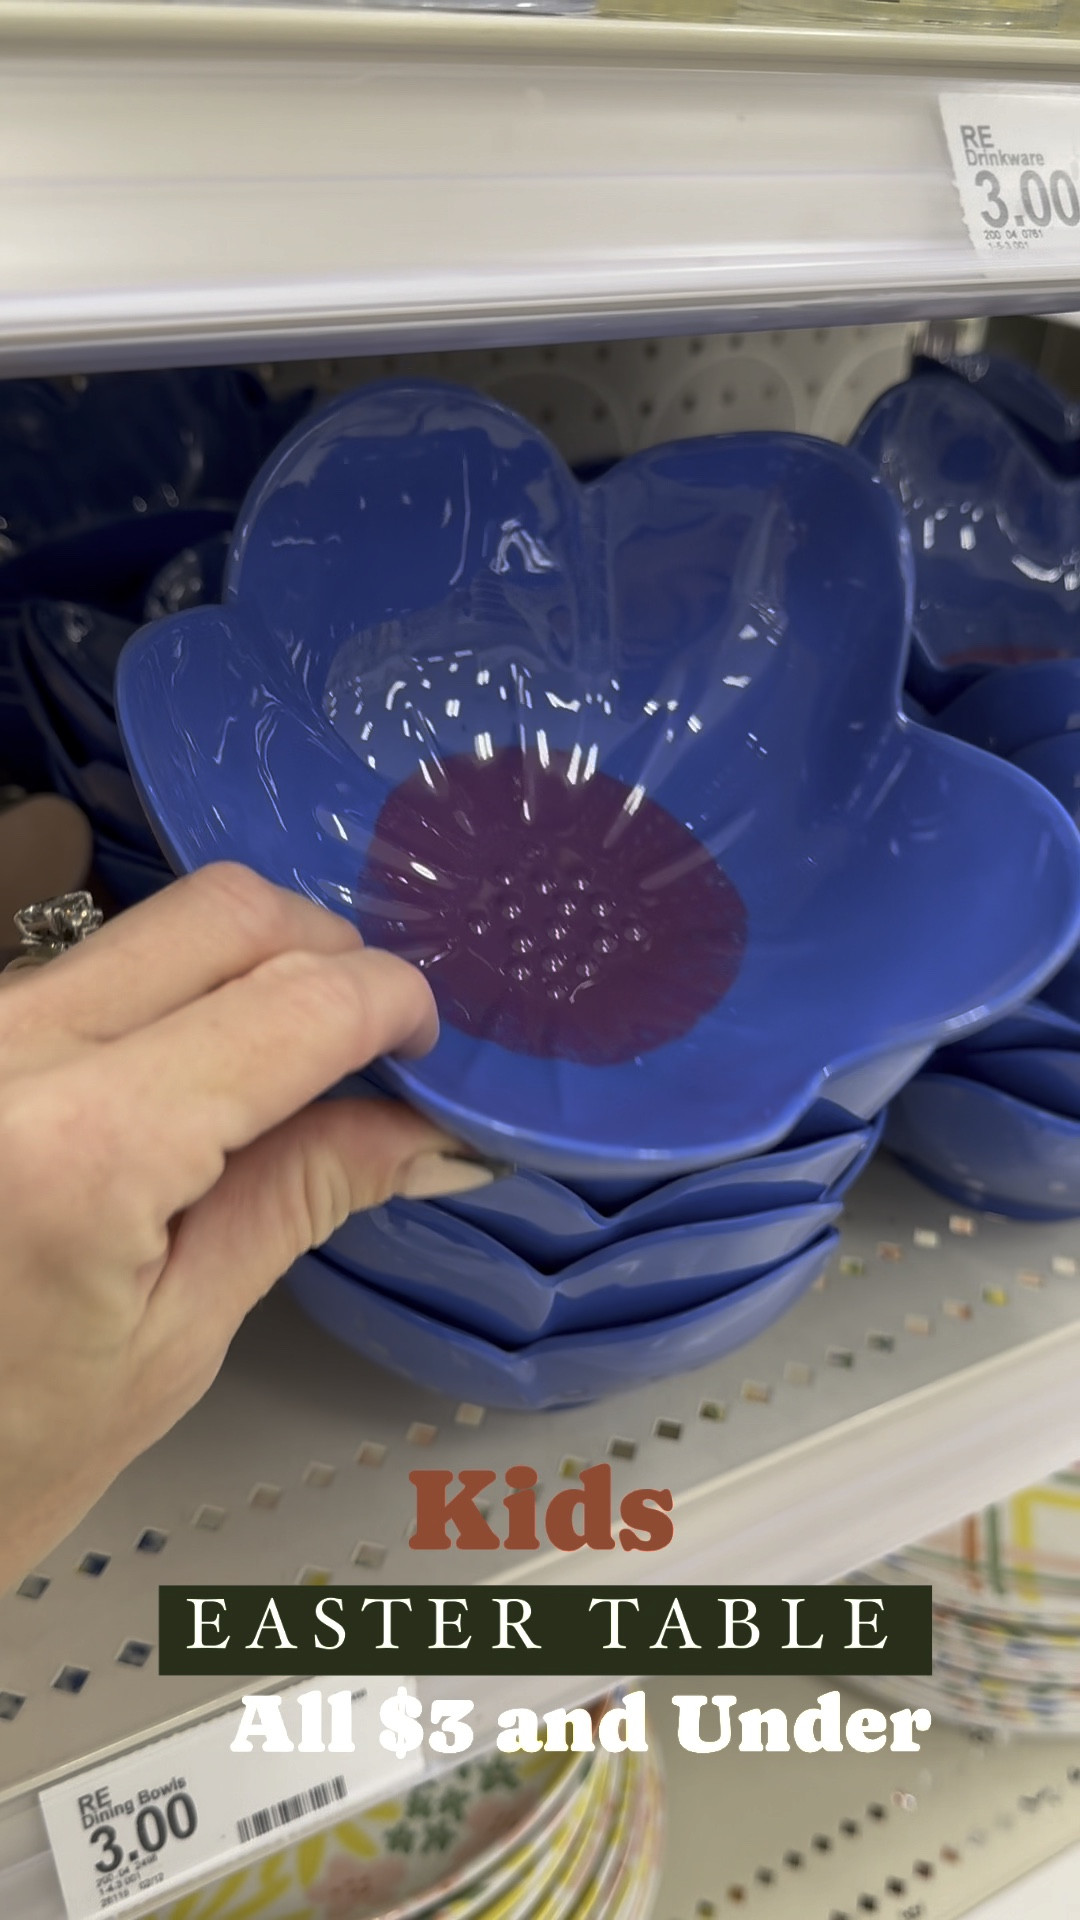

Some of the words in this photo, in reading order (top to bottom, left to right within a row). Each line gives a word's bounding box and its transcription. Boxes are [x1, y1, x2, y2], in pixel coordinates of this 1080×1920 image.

[960, 125, 994, 148] RE
[965, 149, 1045, 166] Drinkware
[975, 170, 1080, 228] 3.00
[78, 1786, 112, 1815] RE
[82, 1799, 134, 1829] Dining
[138, 1776, 187, 1805] Bowls
[90, 1792, 198, 1873] 3.00
